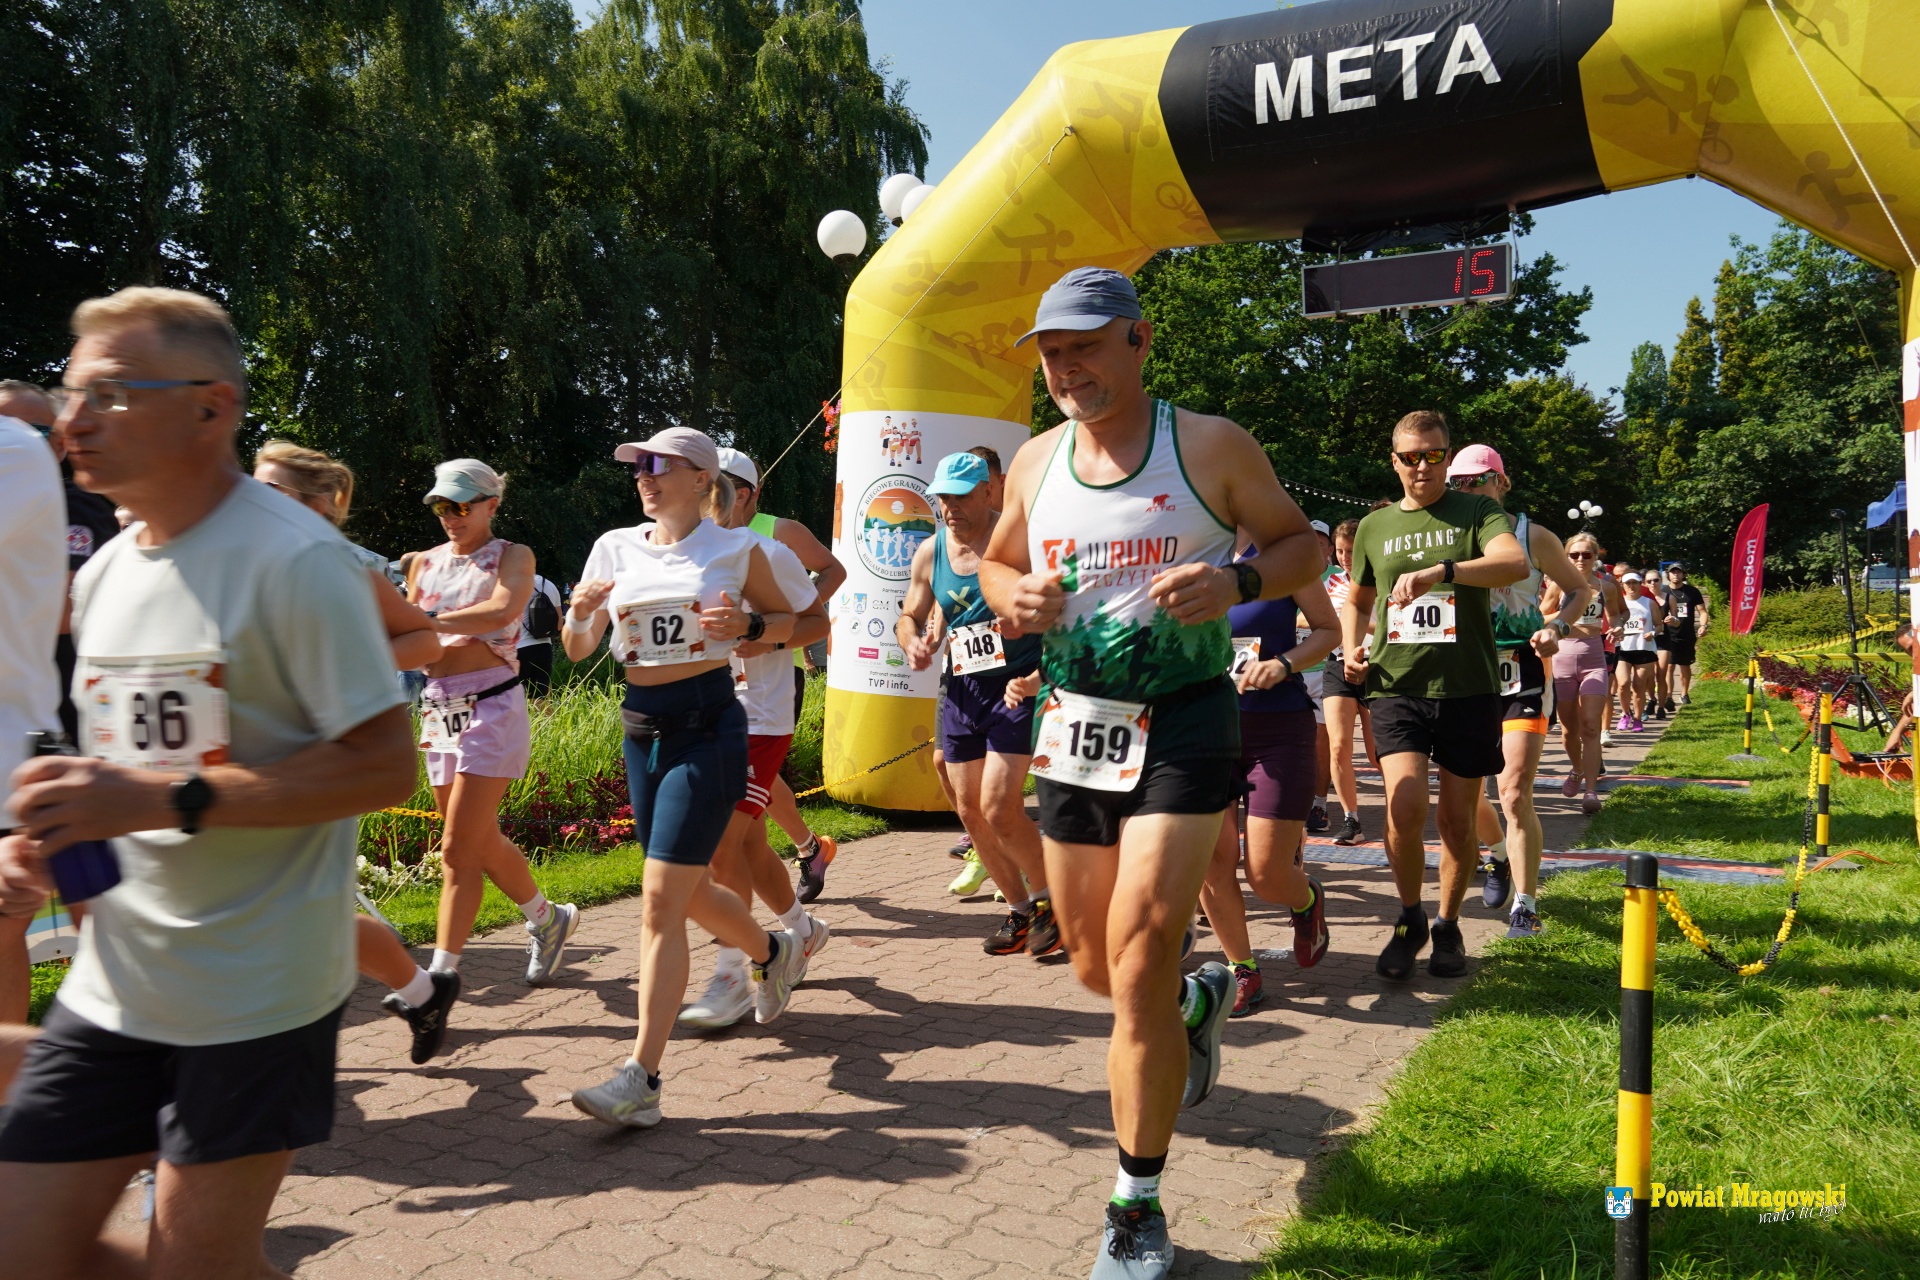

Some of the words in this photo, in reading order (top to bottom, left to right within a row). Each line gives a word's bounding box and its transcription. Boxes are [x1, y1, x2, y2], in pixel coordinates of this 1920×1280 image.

[1254, 22, 1502, 125] META
[1454, 249, 1495, 295] 15
[865, 480, 893, 505] BIEGOWE
[893, 479, 922, 493] GRAND
[1081, 536, 1178, 570] JURUND
[880, 568, 889, 576] BO
[1081, 567, 1171, 590] SZCZYTN
[1740, 538, 1757, 611] Freedom
[1412, 605, 1441, 628] 40
[1626, 620, 1639, 629] 152
[652, 614, 685, 646] 62
[964, 633, 996, 659] 148
[868, 677, 885, 688] TVP
[1068, 720, 1132, 765] 159
